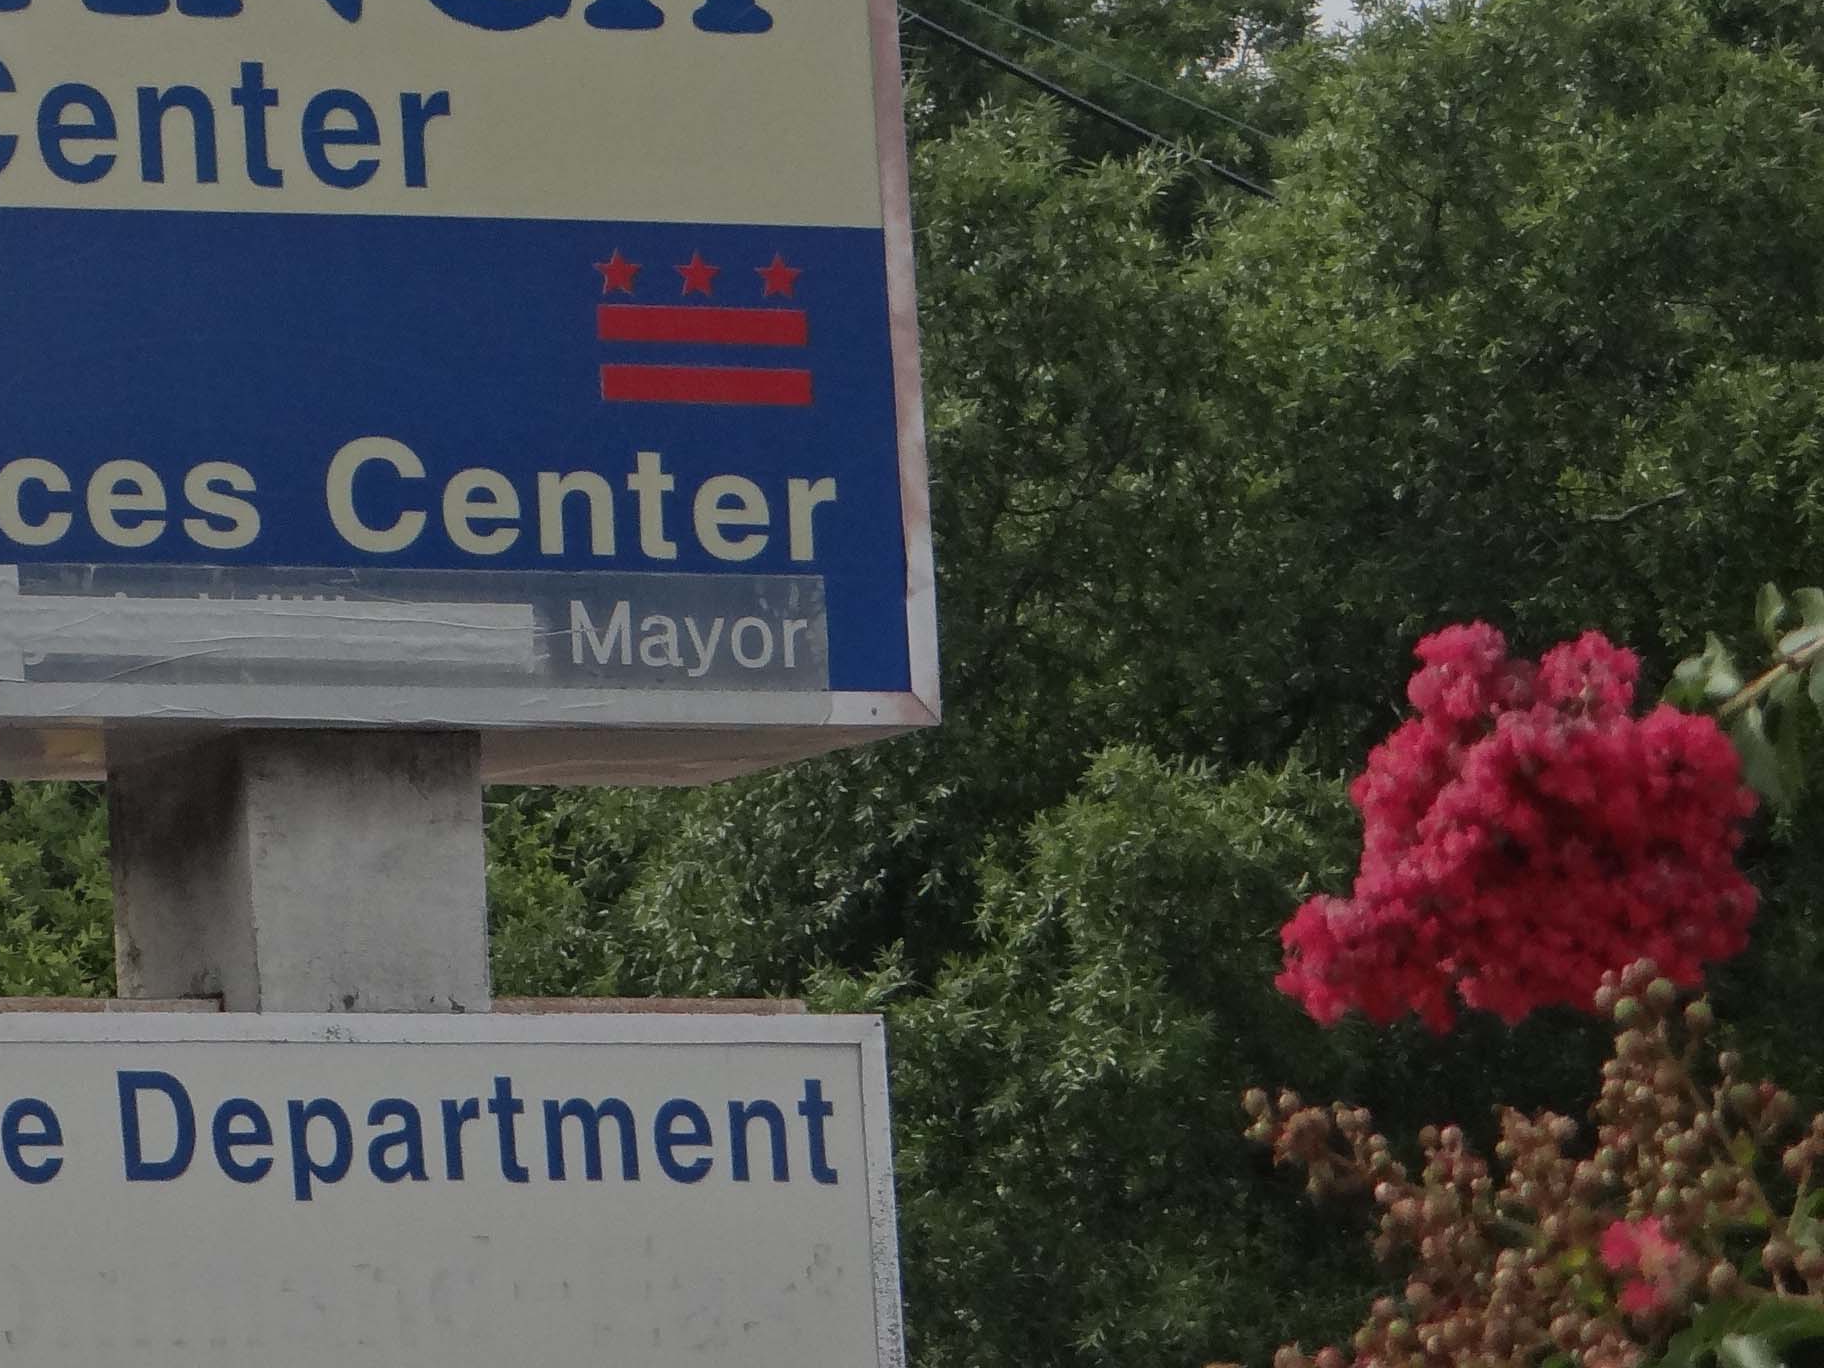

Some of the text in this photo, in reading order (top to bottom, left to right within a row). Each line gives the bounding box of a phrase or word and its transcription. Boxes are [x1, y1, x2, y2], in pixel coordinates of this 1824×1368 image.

[326, 436, 837, 562] Center
[569, 600, 808, 678] Mayor
[117, 1069, 838, 1201] Department
